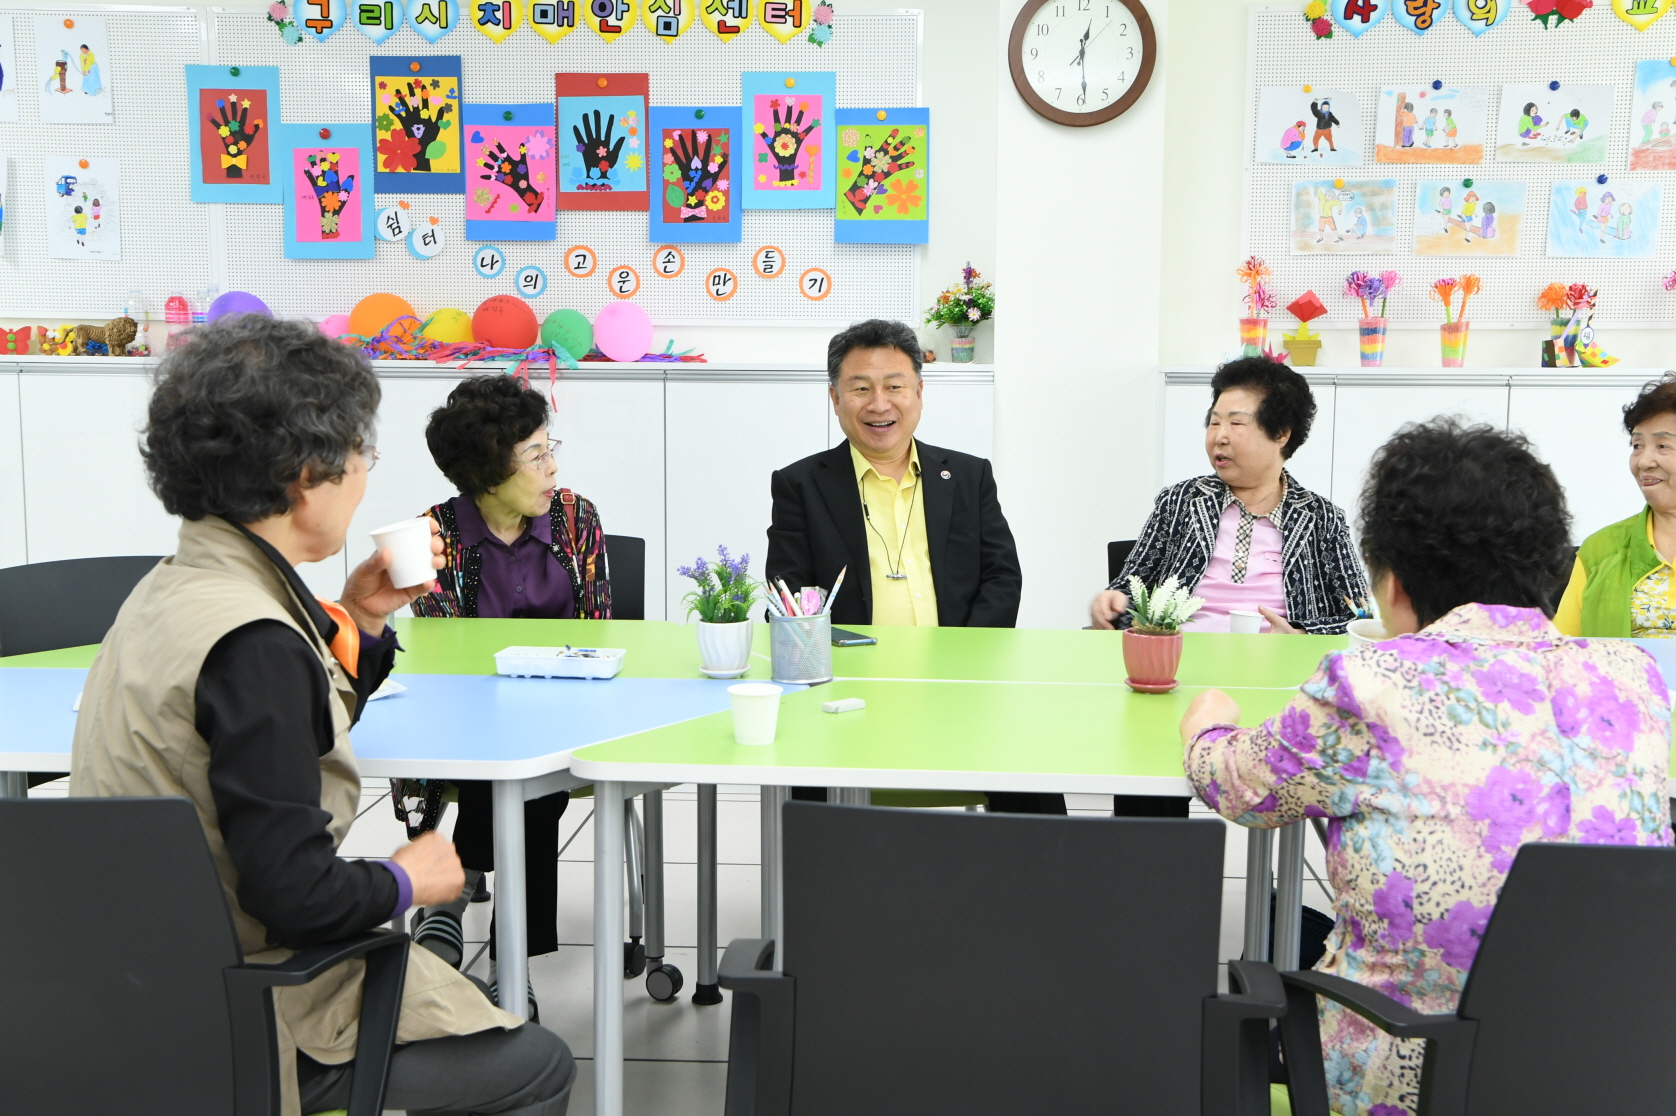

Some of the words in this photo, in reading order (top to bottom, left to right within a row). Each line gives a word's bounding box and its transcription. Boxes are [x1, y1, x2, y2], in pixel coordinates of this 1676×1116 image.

[1055, 5, 1066, 18] 11
[1077, 0, 1091, 11] 12
[1104, 5, 1110, 18] 1
[1036, 23, 1049, 37] 10
[1119, 23, 1128, 37] 2
[1030, 47, 1039, 61] 9
[1125, 46, 1134, 60] 3
[1037, 70, 1045, 83] 8
[1117, 70, 1126, 84] 4
[1054, 87, 1063, 101] 7
[1076, 93, 1086, 107] 6
[1101, 87, 1109, 101] 5
